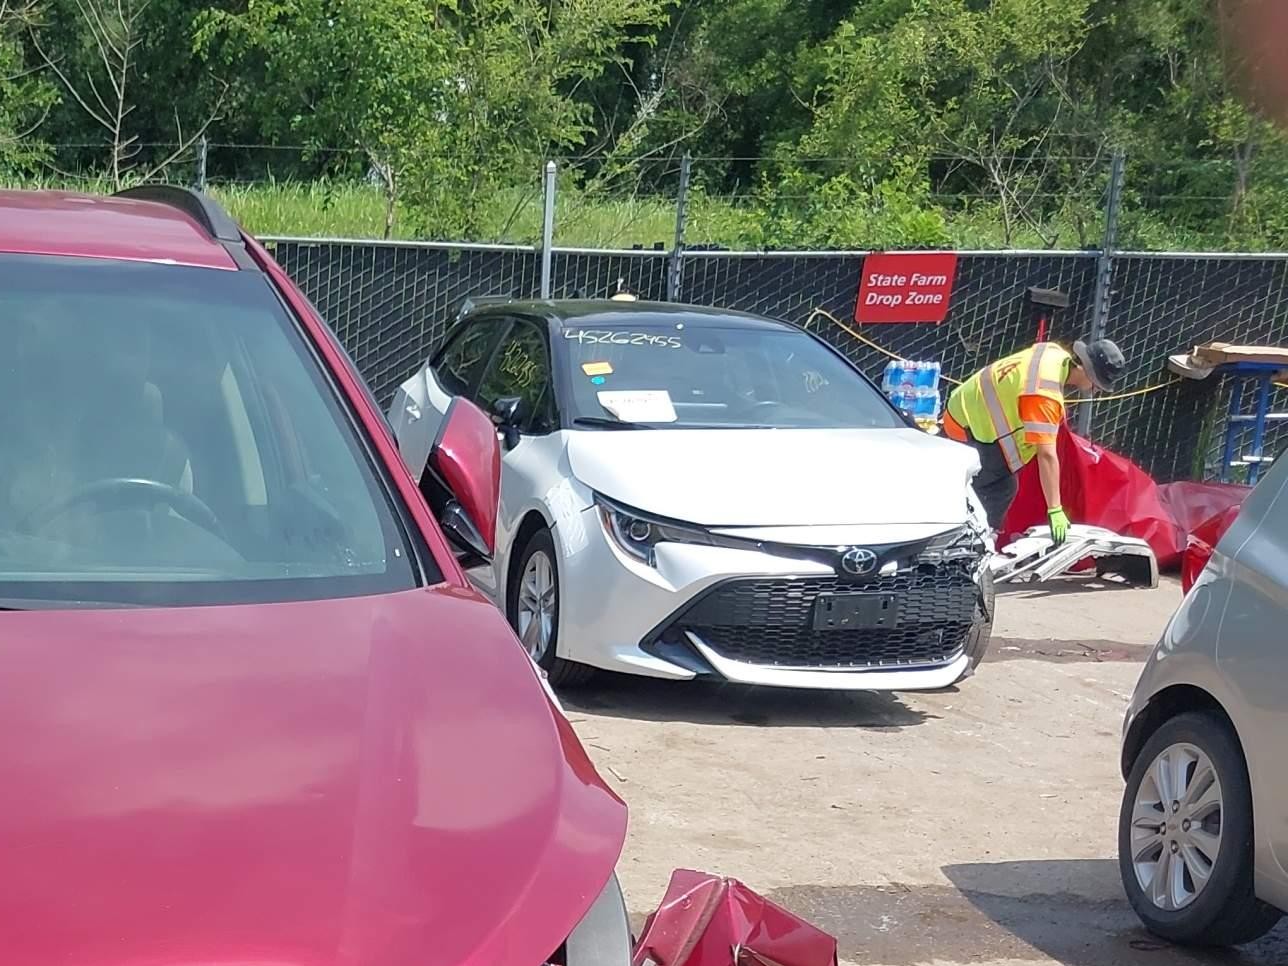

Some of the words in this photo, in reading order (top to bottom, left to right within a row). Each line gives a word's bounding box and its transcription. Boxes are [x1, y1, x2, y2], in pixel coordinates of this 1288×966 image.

[867, 273, 907, 287] State
[910, 273, 947, 286] Farm
[865, 292, 902, 307] Drop
[905, 291, 943, 305] Zone
